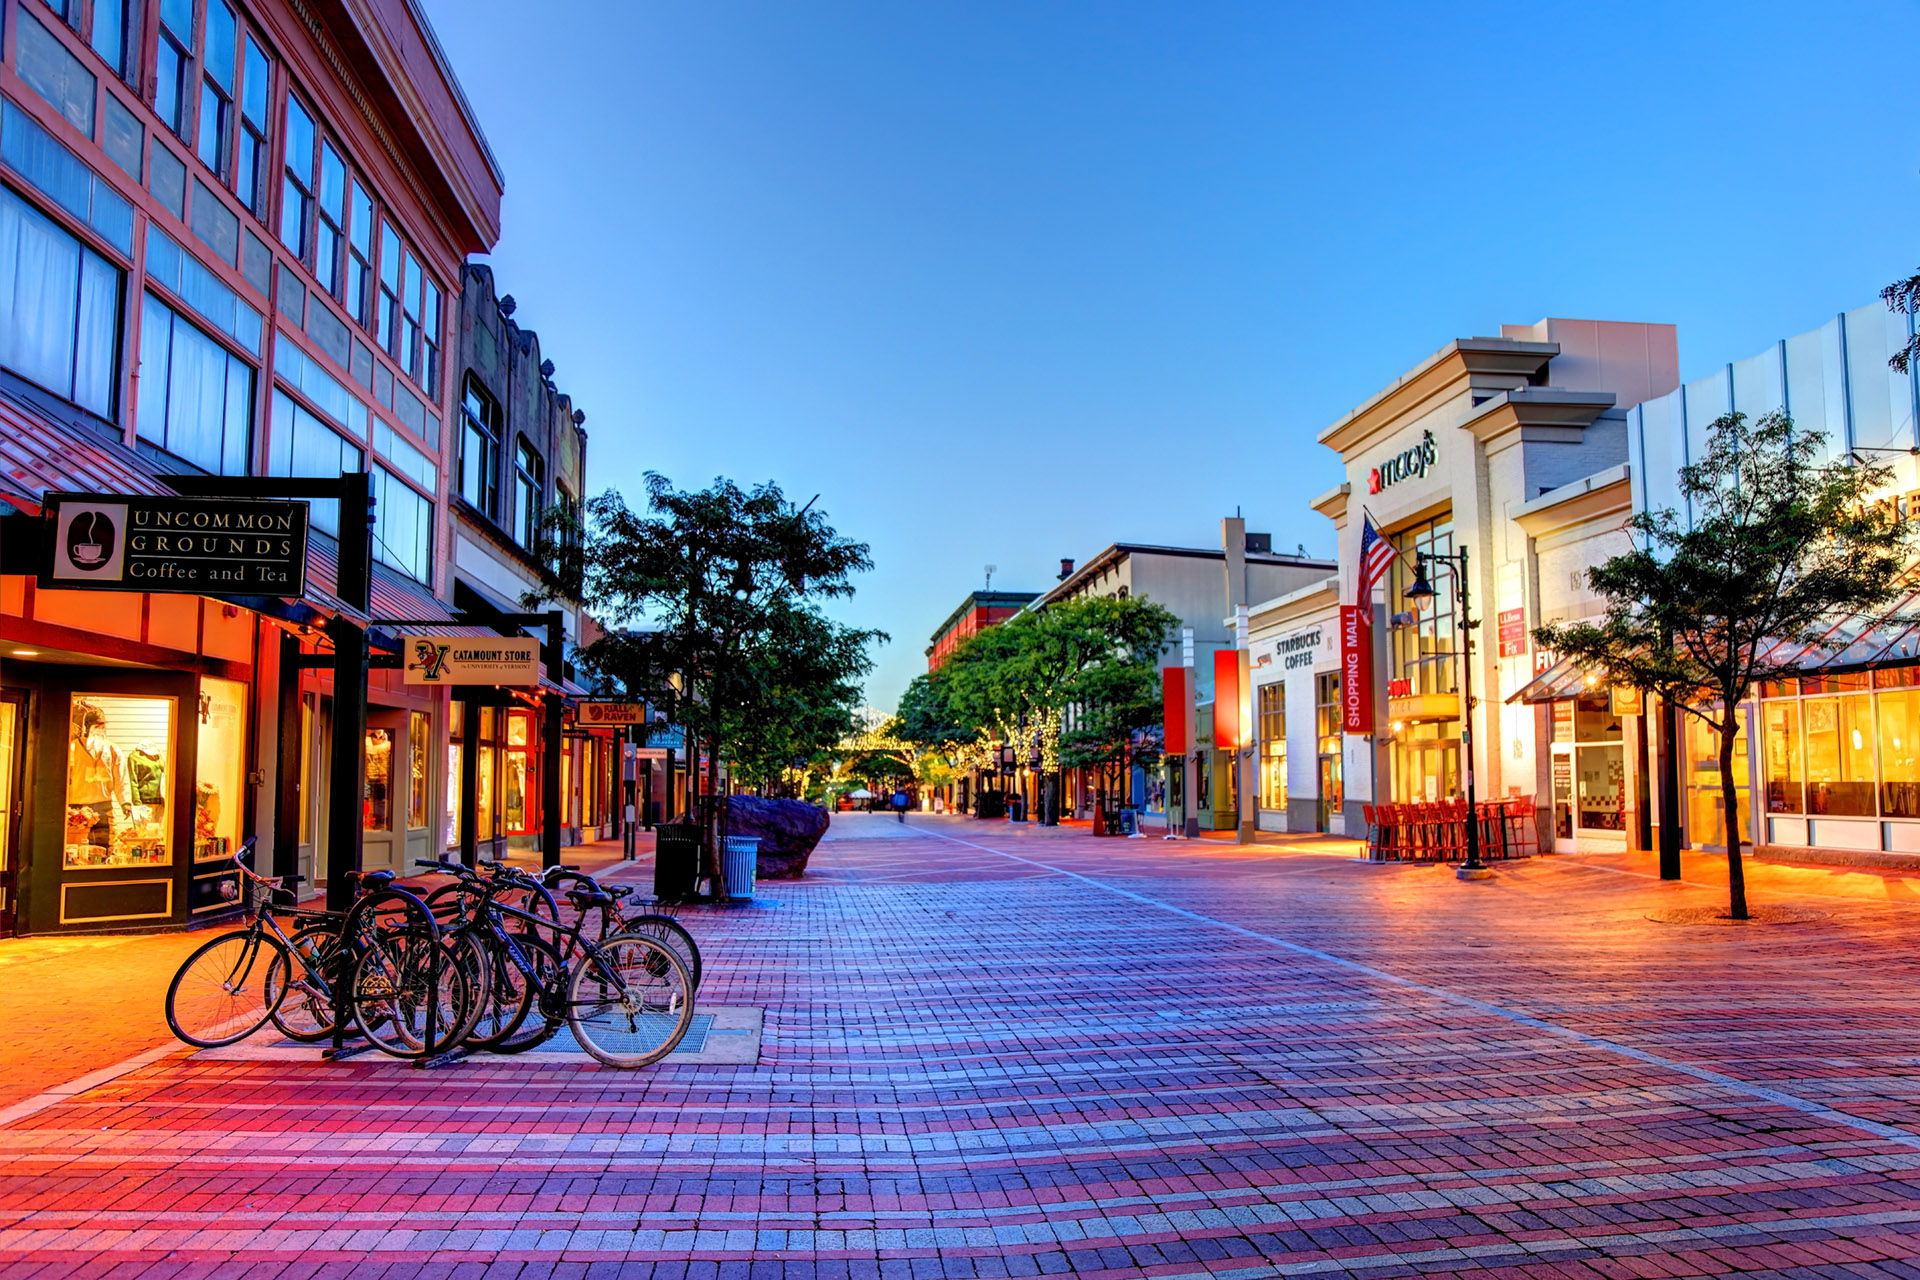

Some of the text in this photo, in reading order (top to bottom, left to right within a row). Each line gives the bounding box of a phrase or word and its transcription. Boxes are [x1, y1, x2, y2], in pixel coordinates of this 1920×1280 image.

[134, 510, 293, 530] UNCOMMON
[131, 535, 291, 556] GROUNDS
[129, 562, 288, 582] Coffee and Tea
[1276, 630, 1321, 655] STARBUCKS
[453, 650, 531, 661] CATAMOUNT STORE
[1285, 650, 1313, 670] COFFEE
[1346, 608, 1360, 727] SHOPPING MALL
[494, 926, 530, 972] SCWINN
